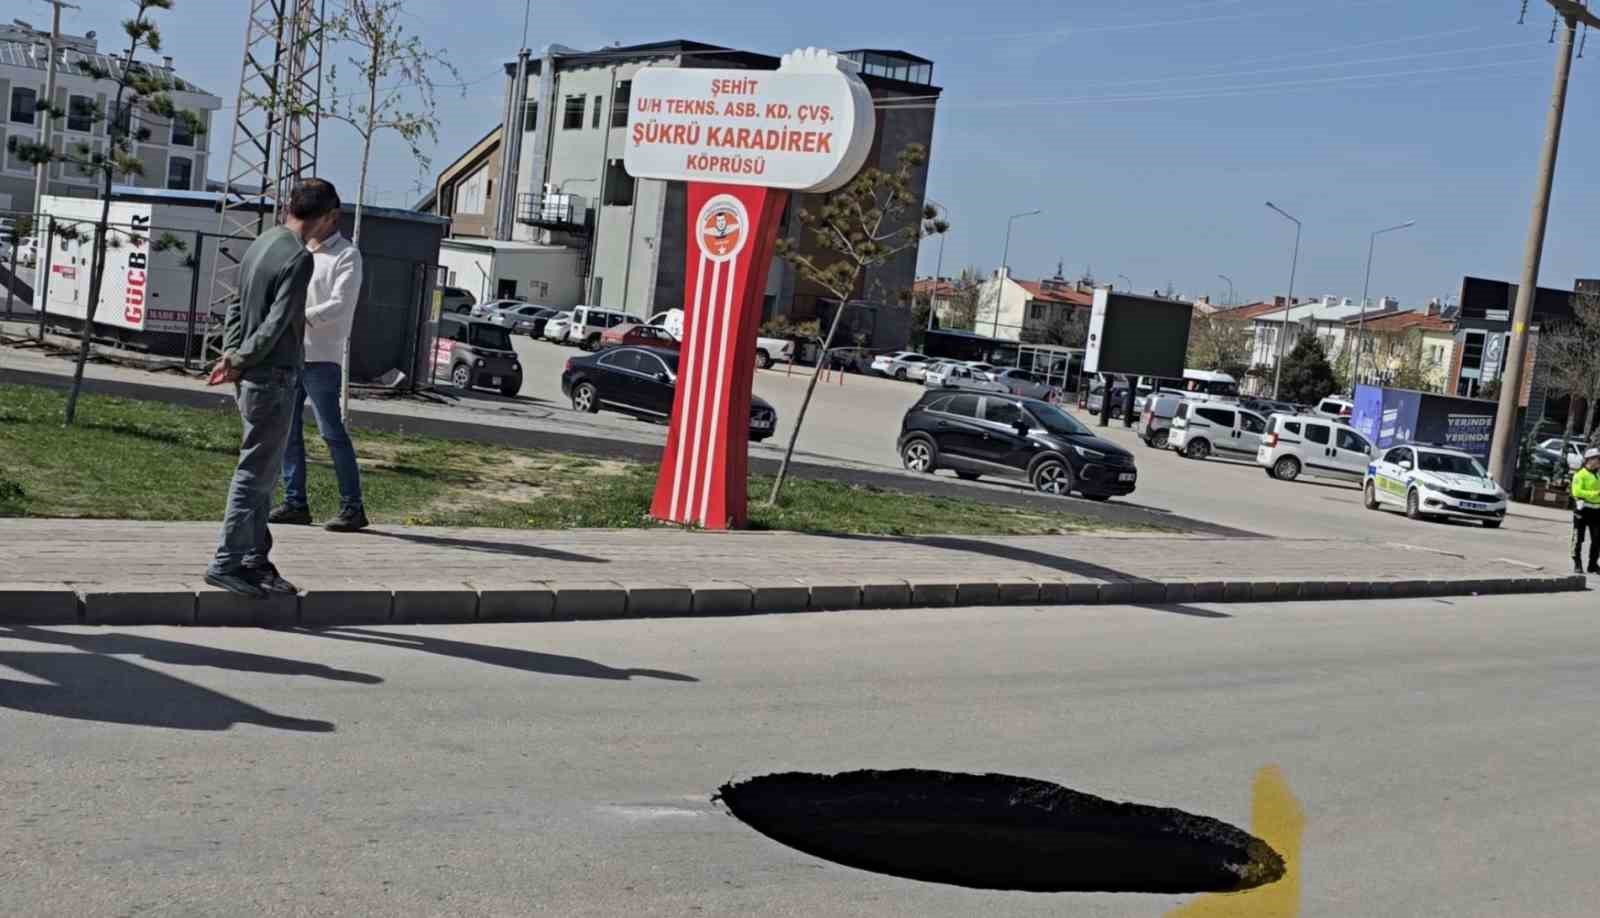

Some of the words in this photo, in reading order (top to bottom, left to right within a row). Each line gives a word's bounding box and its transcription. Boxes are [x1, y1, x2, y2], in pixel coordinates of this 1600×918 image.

[711, 76, 758, 96] ŞEHİT
[637, 97, 661, 113] U/H
[667, 99, 719, 116] TEKNS.
[724, 102, 759, 118] ASB.
[766, 104, 791, 119] KD.
[797, 105, 834, 125] ÇVŞ.
[632, 119, 700, 148] ŞÜKRÜ
[707, 126, 833, 154] KARADİREK
[687, 153, 765, 175] KÖPRÜSÜ
